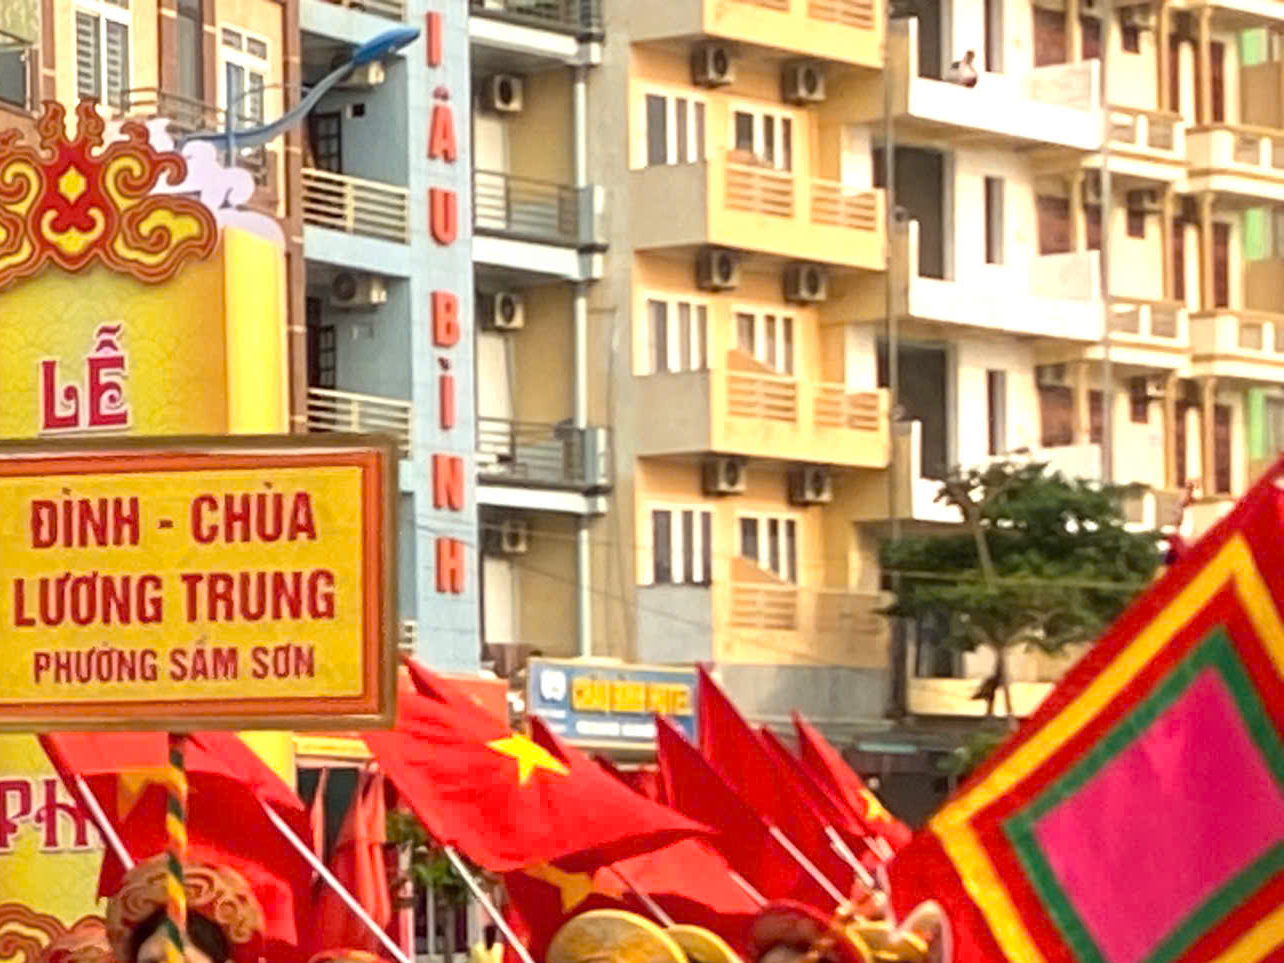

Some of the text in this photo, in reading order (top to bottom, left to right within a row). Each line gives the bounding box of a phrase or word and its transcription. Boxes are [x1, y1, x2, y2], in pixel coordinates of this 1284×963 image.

[41, 323, 128, 430] LỄ
[430, 290, 464, 594] BÌNH
[31, 487, 140, 549] ĐÌNH
[191, 481, 316, 545] CHÙA
[13, 569, 335, 627] LƯƠNG TRUNG
[34, 640, 159, 683] PHƯỜNG
[252, 641, 315, 680] SƠN
